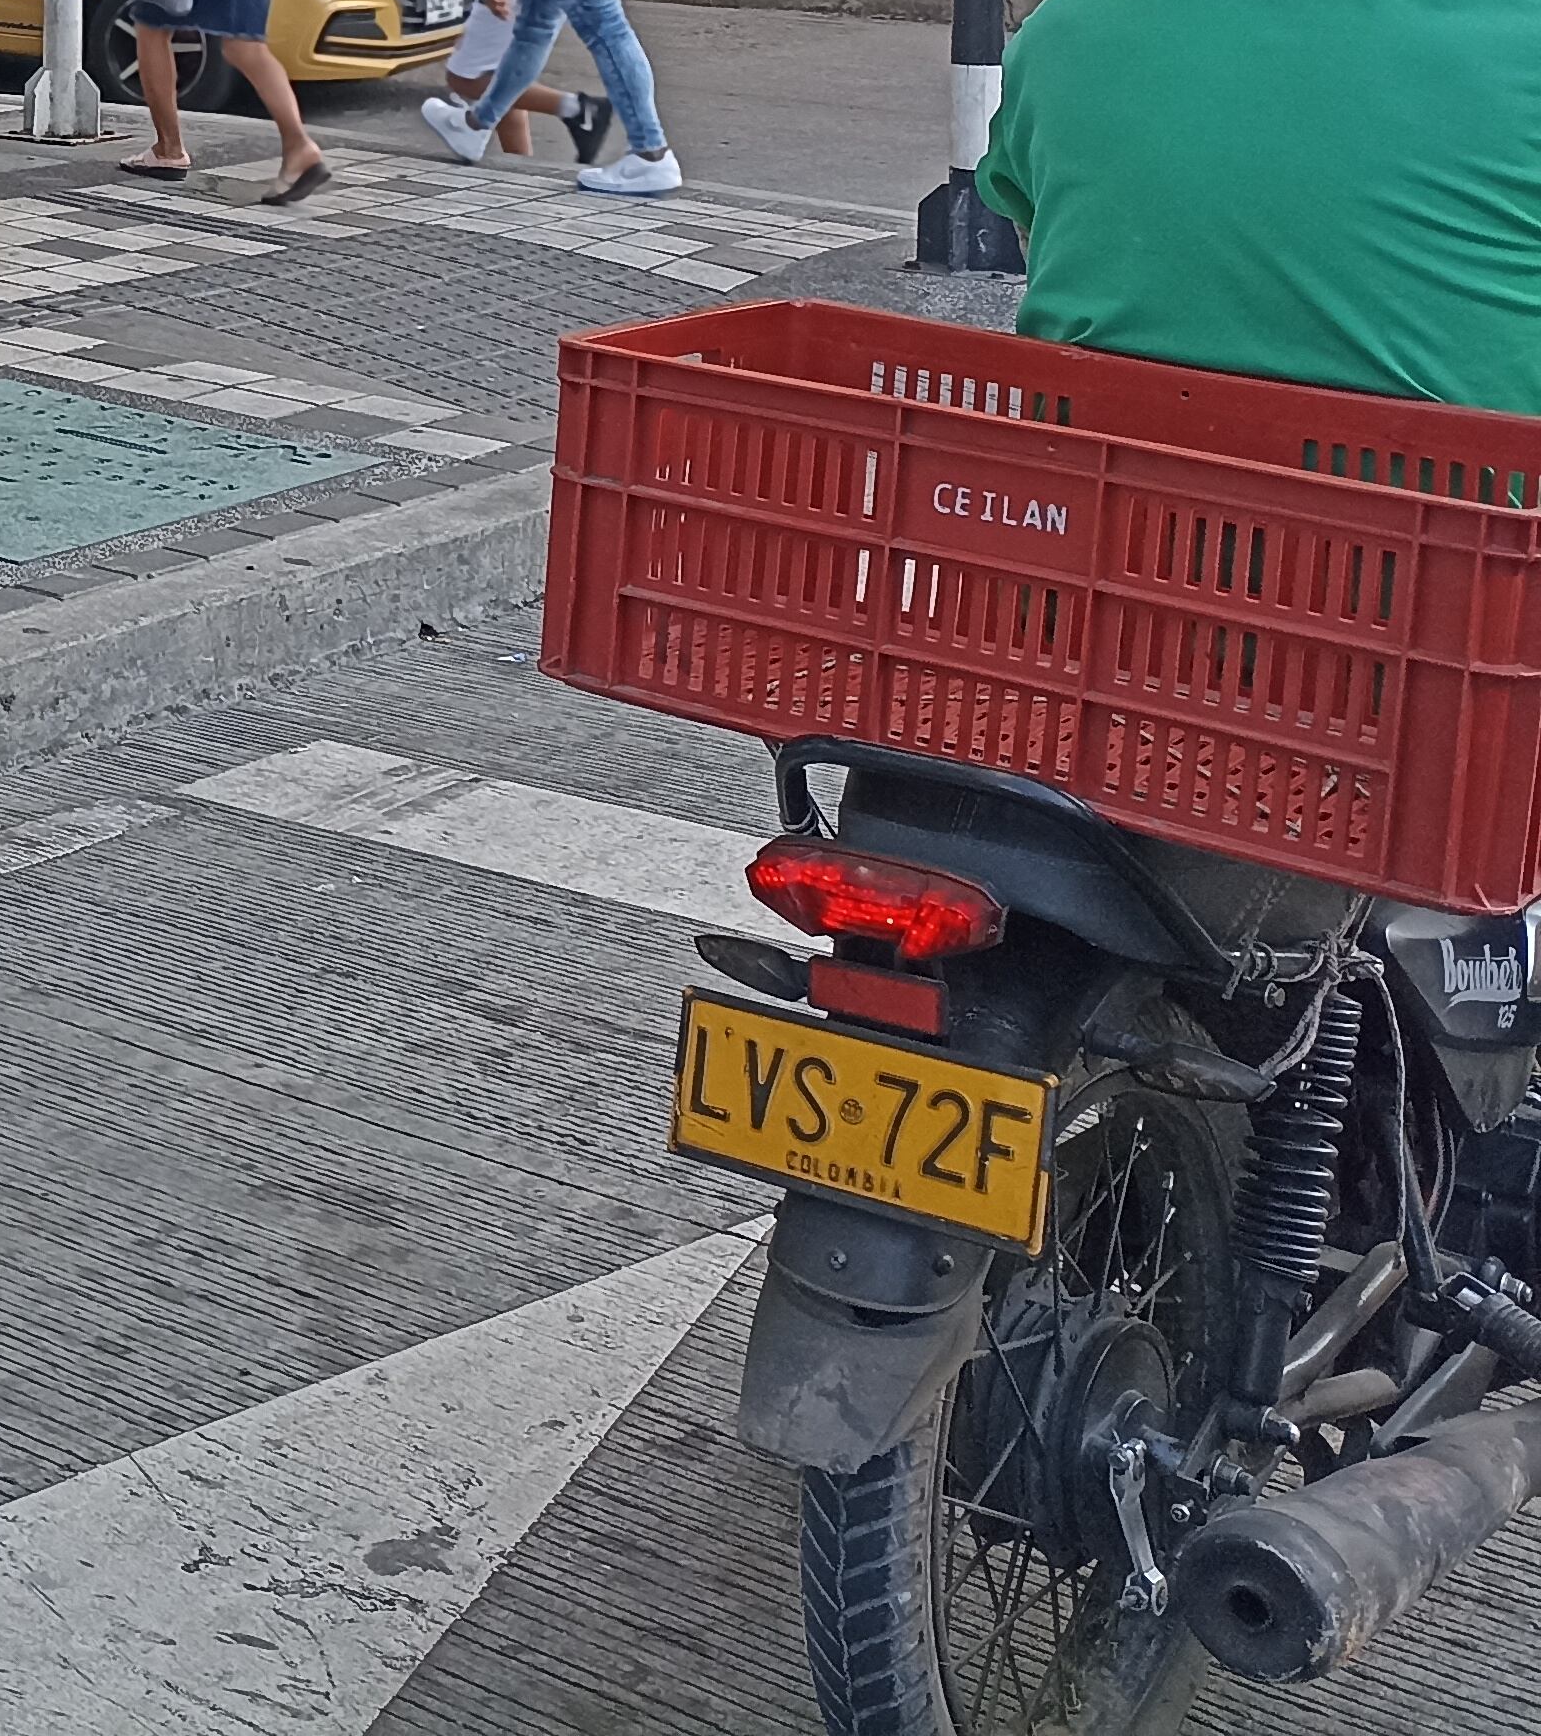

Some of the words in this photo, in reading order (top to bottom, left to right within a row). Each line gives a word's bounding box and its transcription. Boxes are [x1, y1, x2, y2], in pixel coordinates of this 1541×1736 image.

[933, 483, 1067, 535] CEILAN
[1438, 937, 1523, 998] Bomber
[1497, 1004, 1518, 1029] 125
[690, 1026, 836, 1144] LVS
[875, 1070, 1032, 1193] 72F
[784, 1150, 904, 1201] COLOMBIA
